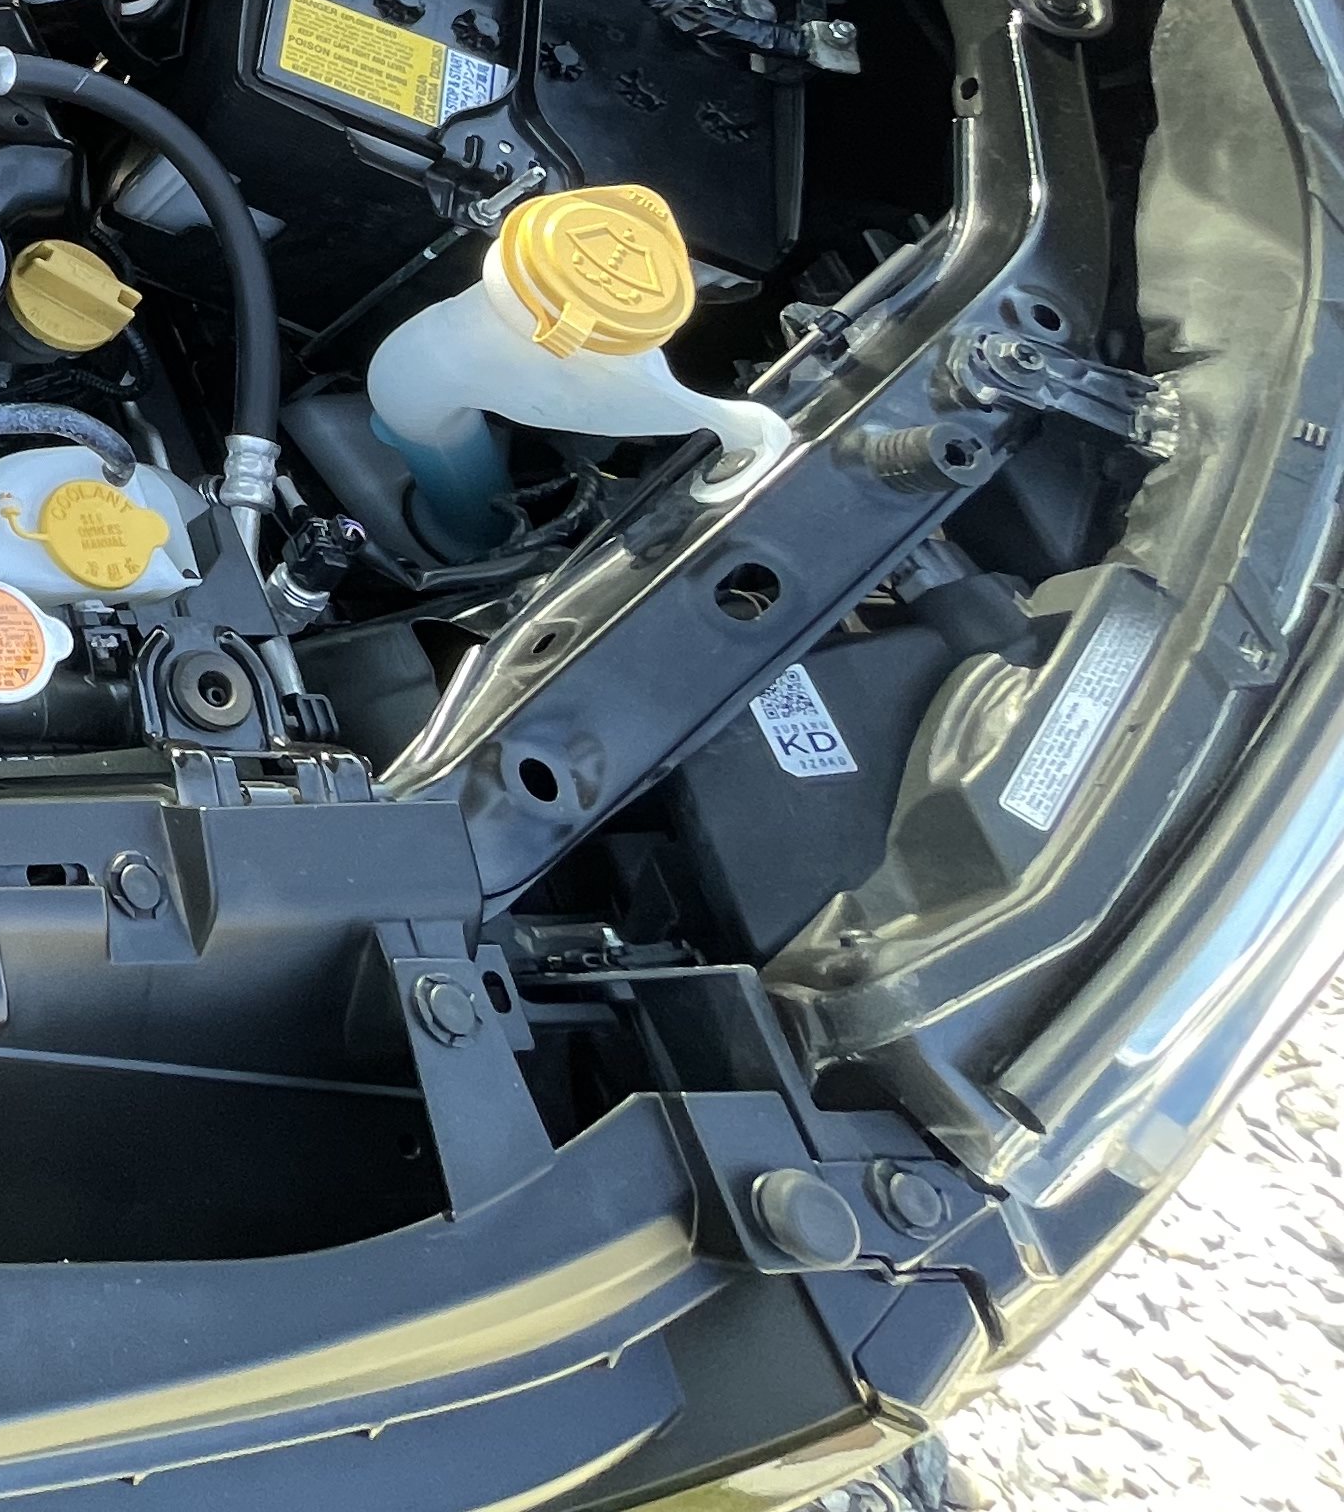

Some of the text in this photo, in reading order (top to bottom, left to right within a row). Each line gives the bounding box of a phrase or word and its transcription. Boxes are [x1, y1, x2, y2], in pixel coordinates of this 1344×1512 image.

[288, 34, 330, 56] POISON
[315, 34, 332, 45] VENT
[333, 40, 351, 52] CAPS
[449, 52, 462, 79] START
[446, 86, 457, 109] STOP
[50, 484, 133, 521] COOLANT
[772, 720, 830, 734] SUBARU
[776, 731, 838, 756] KD
